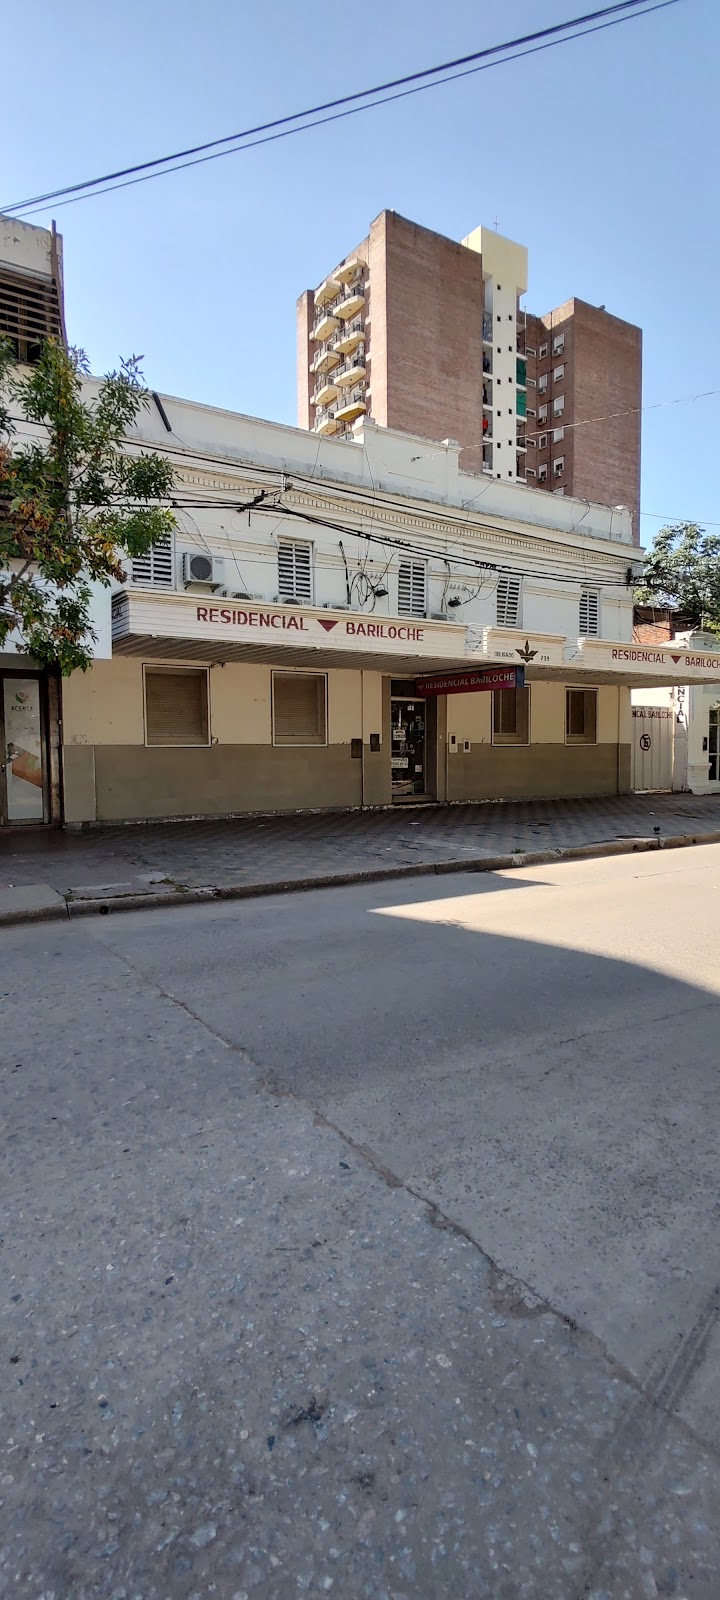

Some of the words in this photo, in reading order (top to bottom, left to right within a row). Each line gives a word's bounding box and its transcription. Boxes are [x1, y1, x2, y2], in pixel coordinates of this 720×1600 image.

[196, 606, 309, 631] RESIDENCIAL
[346, 621, 424, 641] BARILOCHE
[612, 649, 666, 664] RESIDENCIAL
[425, 678, 469, 689] RESIDENCIAL
[470, 672, 515, 685] BARILOCHE
